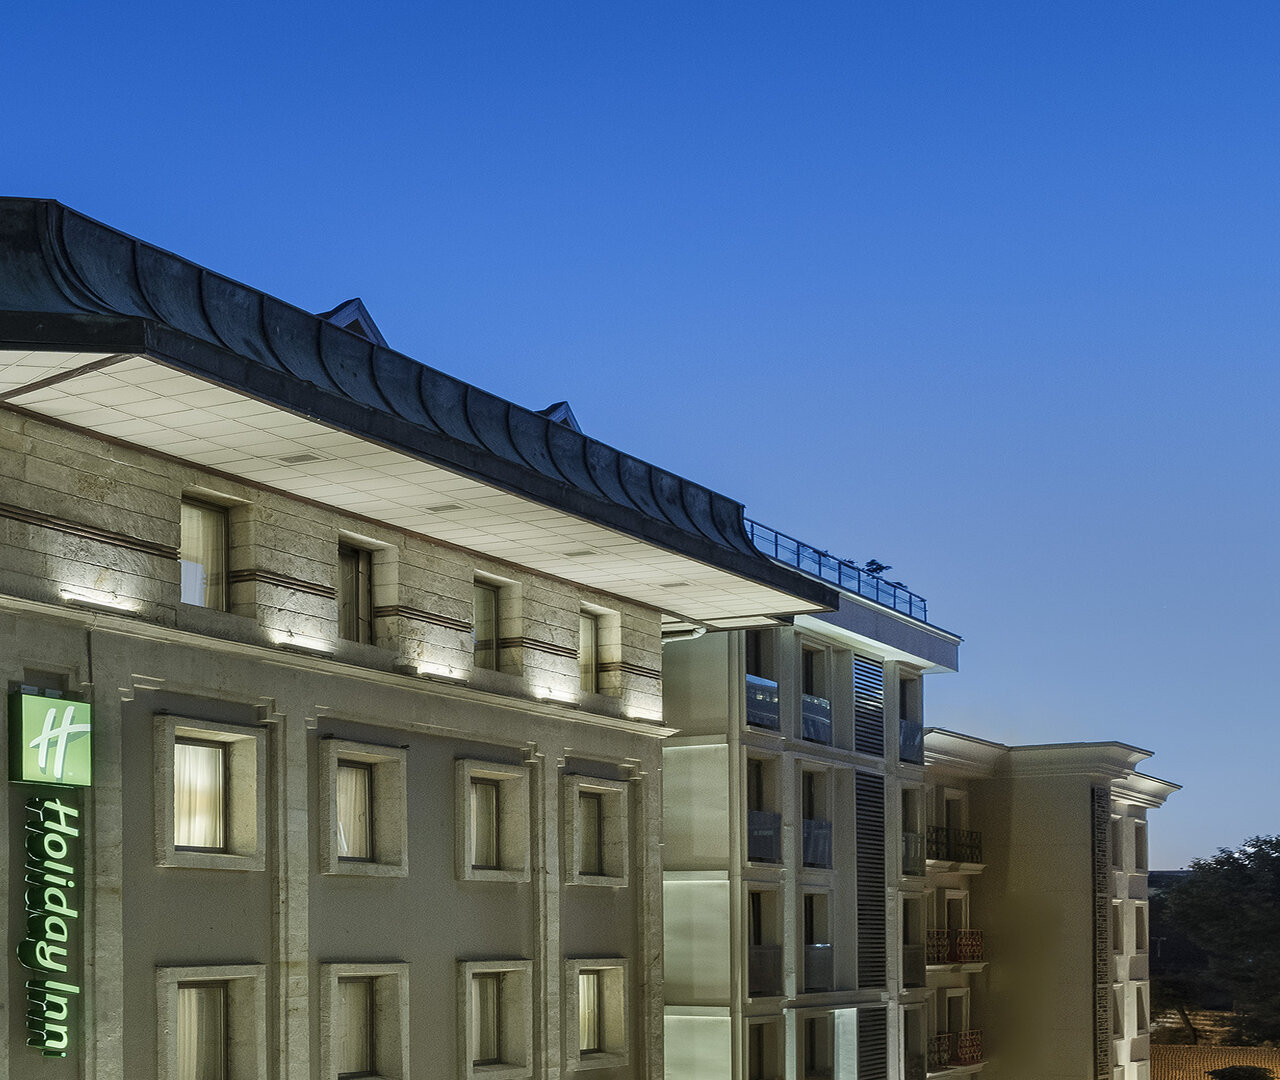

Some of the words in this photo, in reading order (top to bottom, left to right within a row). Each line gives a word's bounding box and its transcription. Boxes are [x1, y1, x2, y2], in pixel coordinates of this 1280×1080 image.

[29, 705, 91, 778] H
[36, 799, 79, 972] Holiday
[45, 980, 80, 1049] Inn
